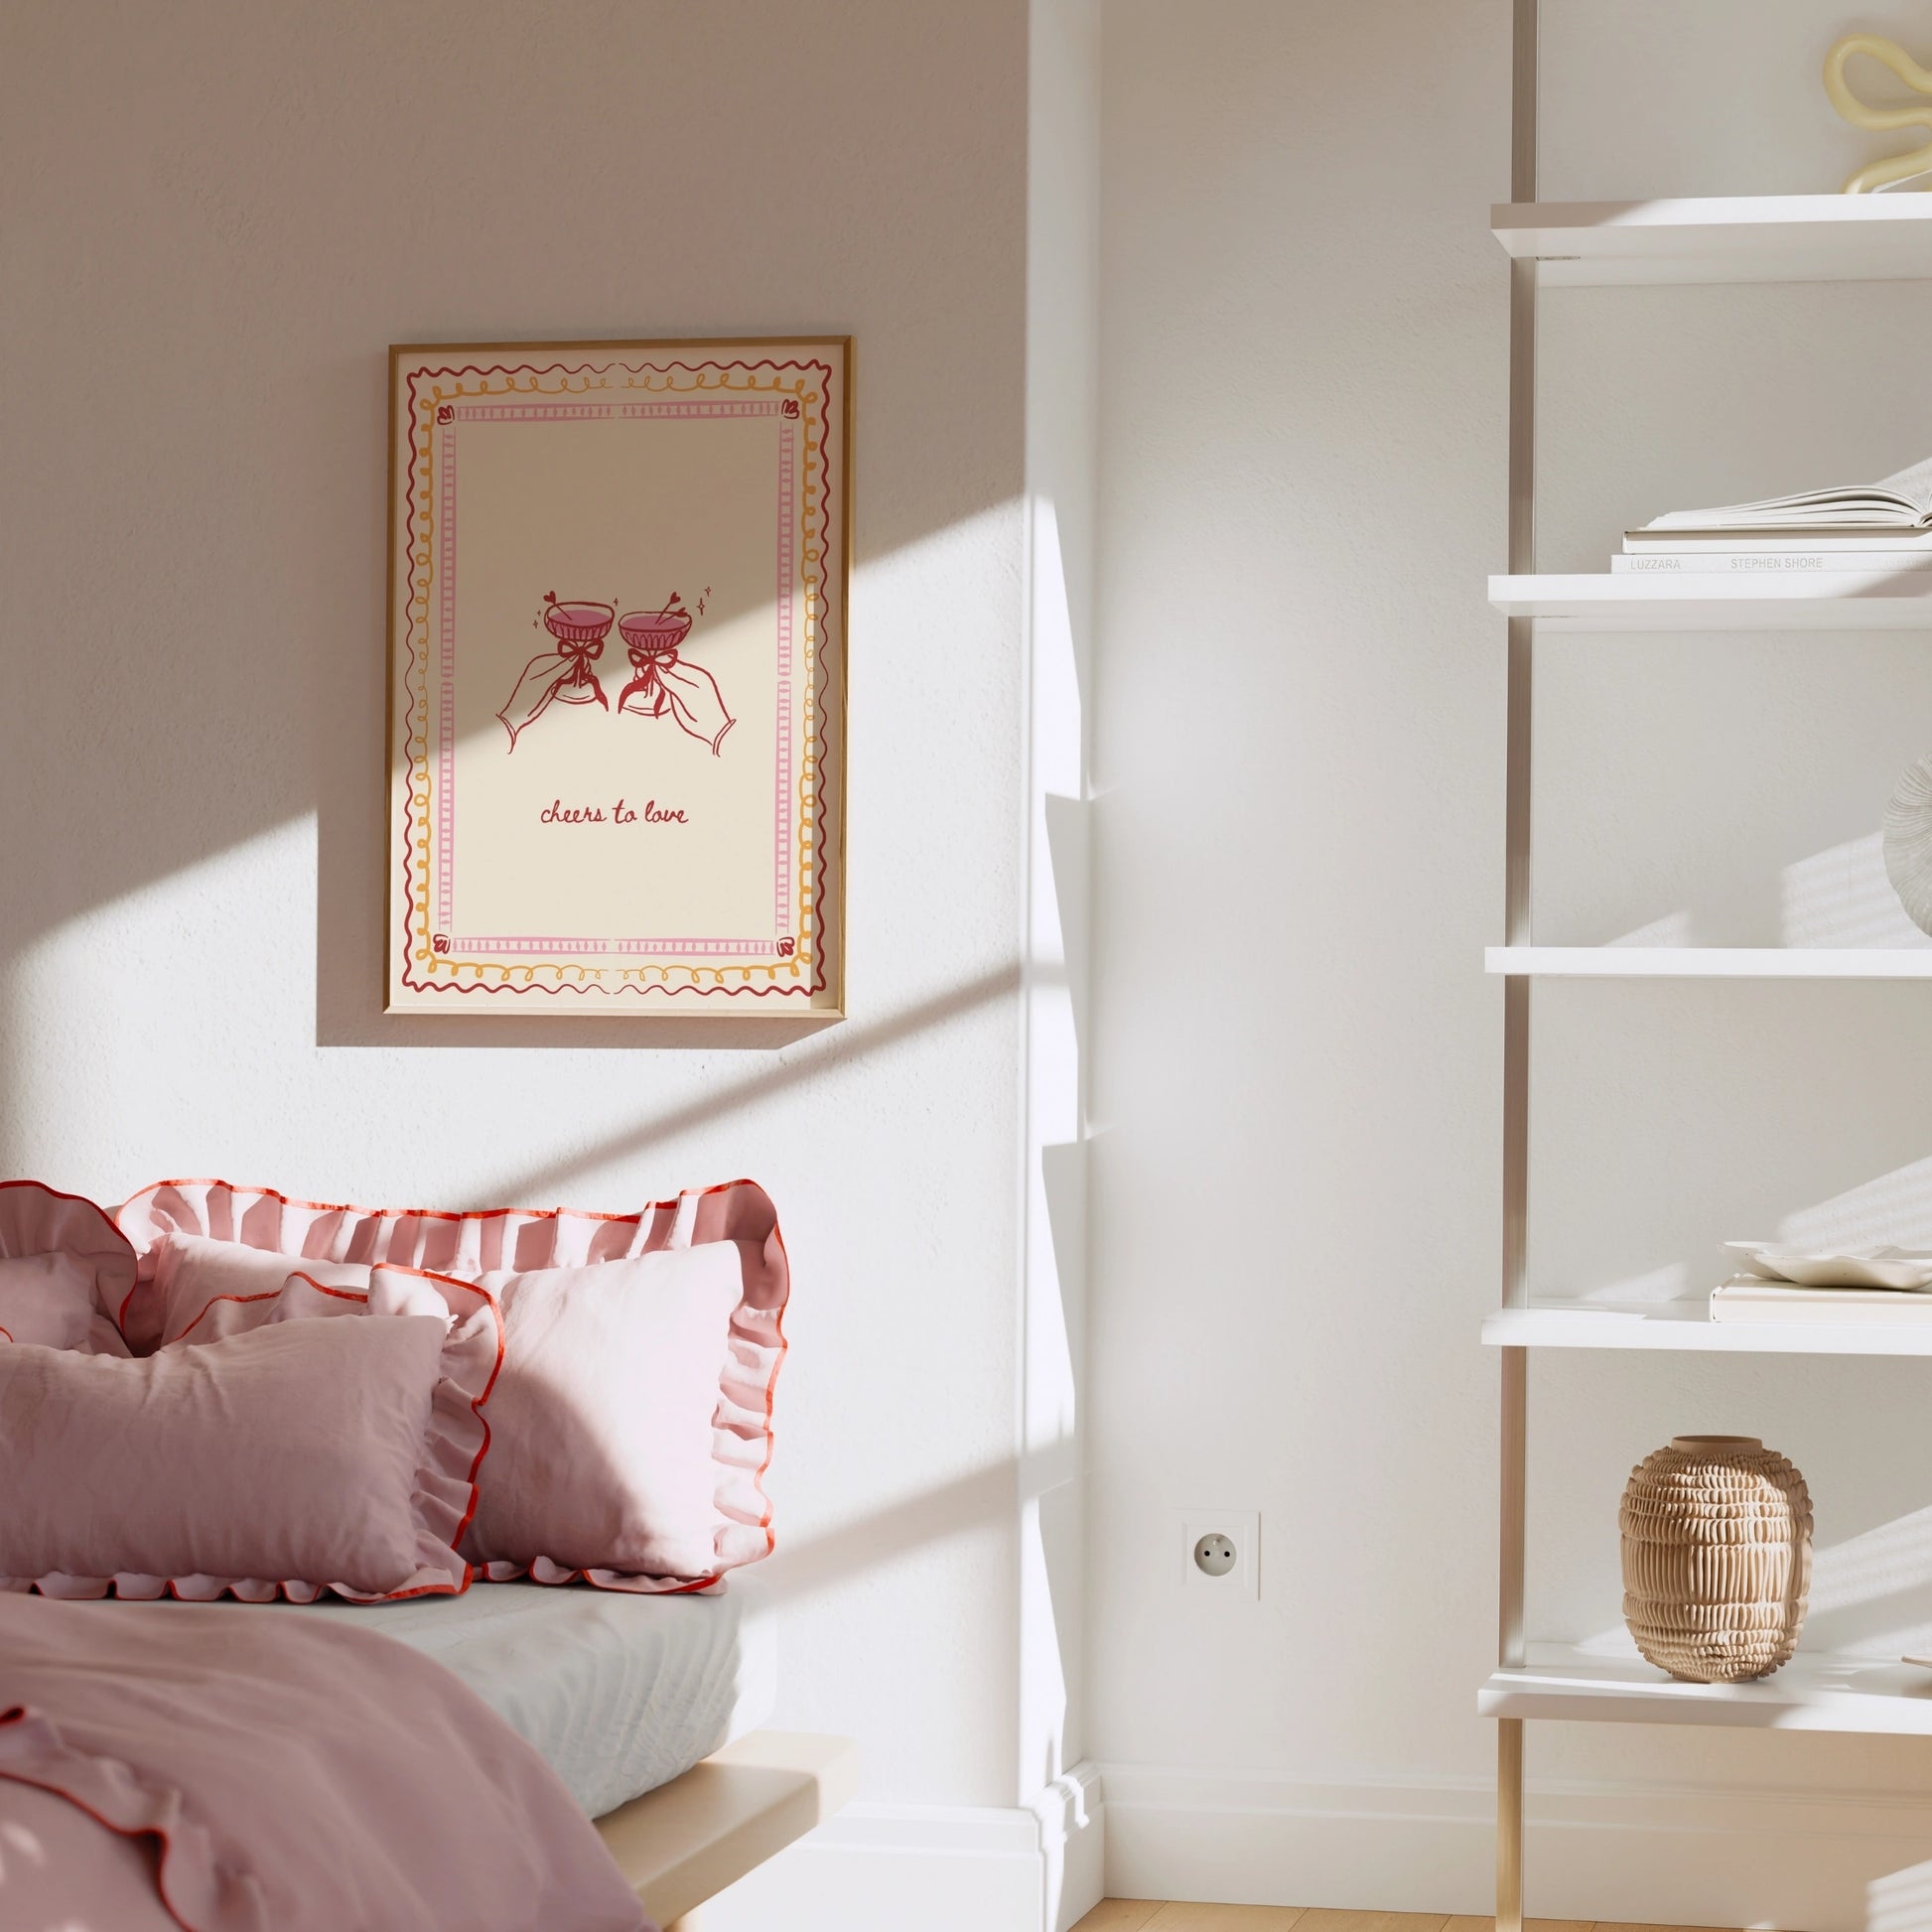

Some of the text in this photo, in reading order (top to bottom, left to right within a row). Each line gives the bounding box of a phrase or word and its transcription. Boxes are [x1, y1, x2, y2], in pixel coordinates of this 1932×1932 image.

[1630, 557, 1823, 570] LUZZARA STEPHEN SHORE
[540, 798, 689, 824] cheers to love
